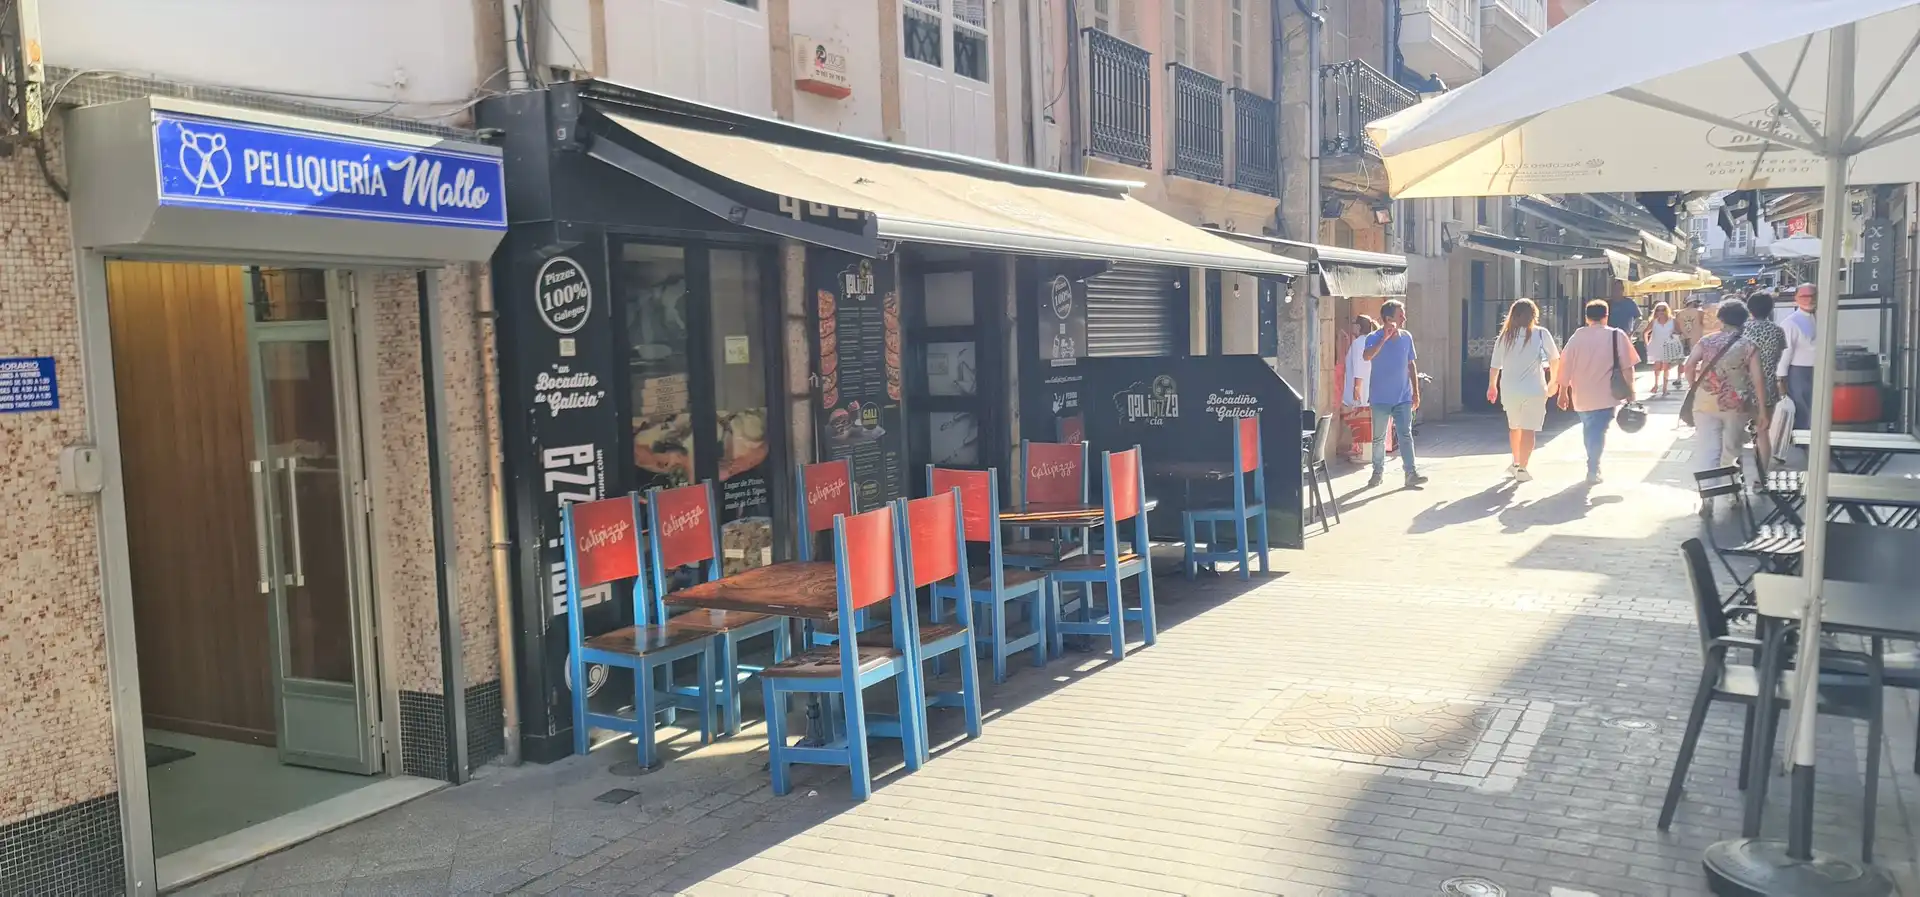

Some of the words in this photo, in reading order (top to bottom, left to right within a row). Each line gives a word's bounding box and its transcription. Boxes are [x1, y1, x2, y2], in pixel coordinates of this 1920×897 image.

[243, 148, 388, 197] PELUQUERÍA
[387, 155, 490, 212] Mallo
[543, 281, 587, 312] 100%
[535, 372, 598, 391] Bocadiño
[1206, 394, 1258, 405] Bocadiño
